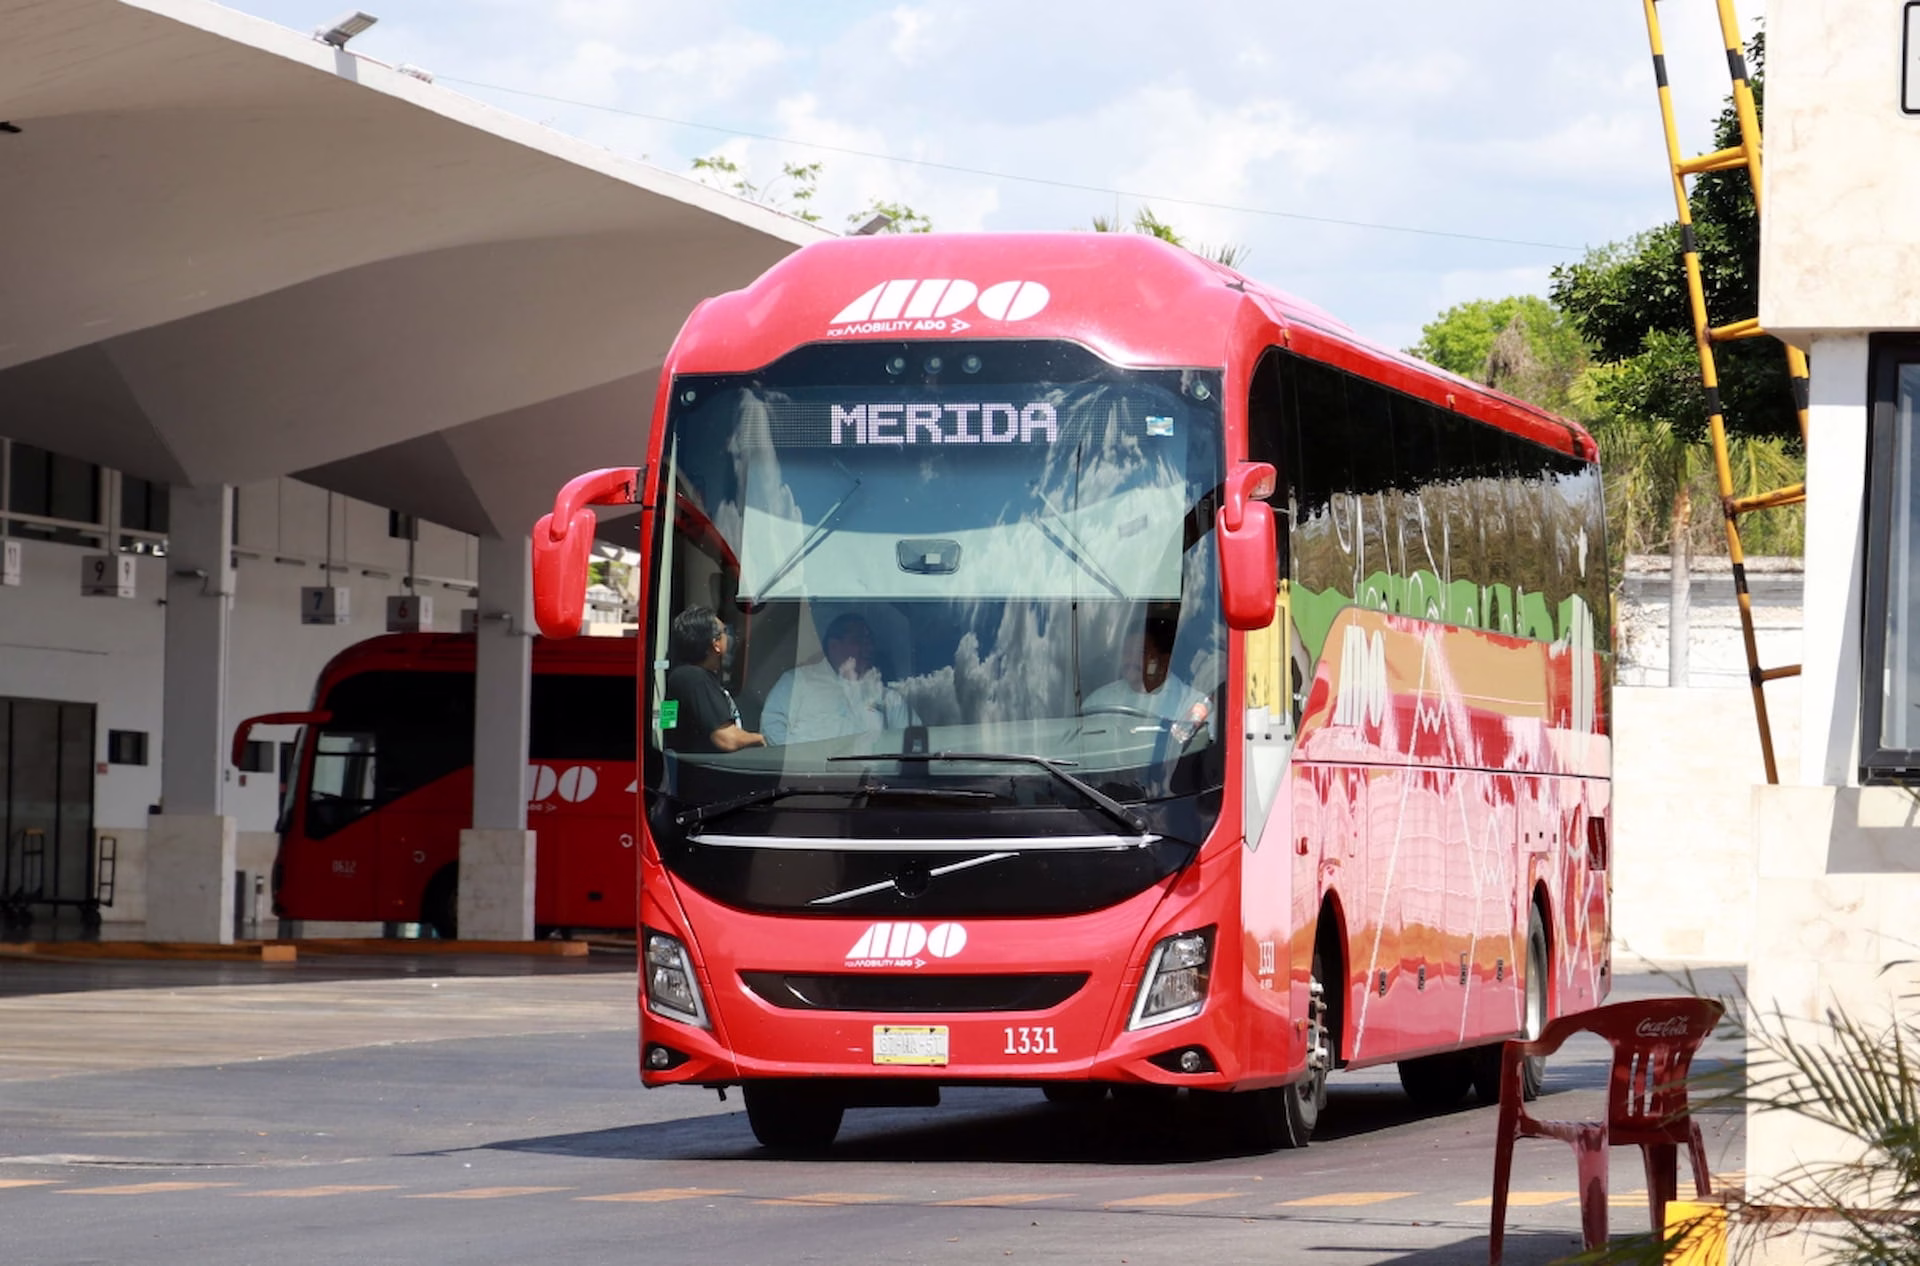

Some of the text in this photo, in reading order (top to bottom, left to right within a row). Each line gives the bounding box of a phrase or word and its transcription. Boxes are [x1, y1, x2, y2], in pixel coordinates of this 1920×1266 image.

[829, 279, 1051, 324] ADO
[843, 320, 913, 336] MOBILITY
[914, 319, 946, 331] ADO
[831, 403, 1057, 444] MERIDA
[95, 560, 104, 581] 9
[313, 591, 323, 610] 7
[398, 601, 408, 619] 6
[528, 764, 598, 802] DO
[845, 922, 968, 958] ADO
[854, 960, 895, 968] MOBILITY
[1003, 1027, 1059, 1054] 1331
